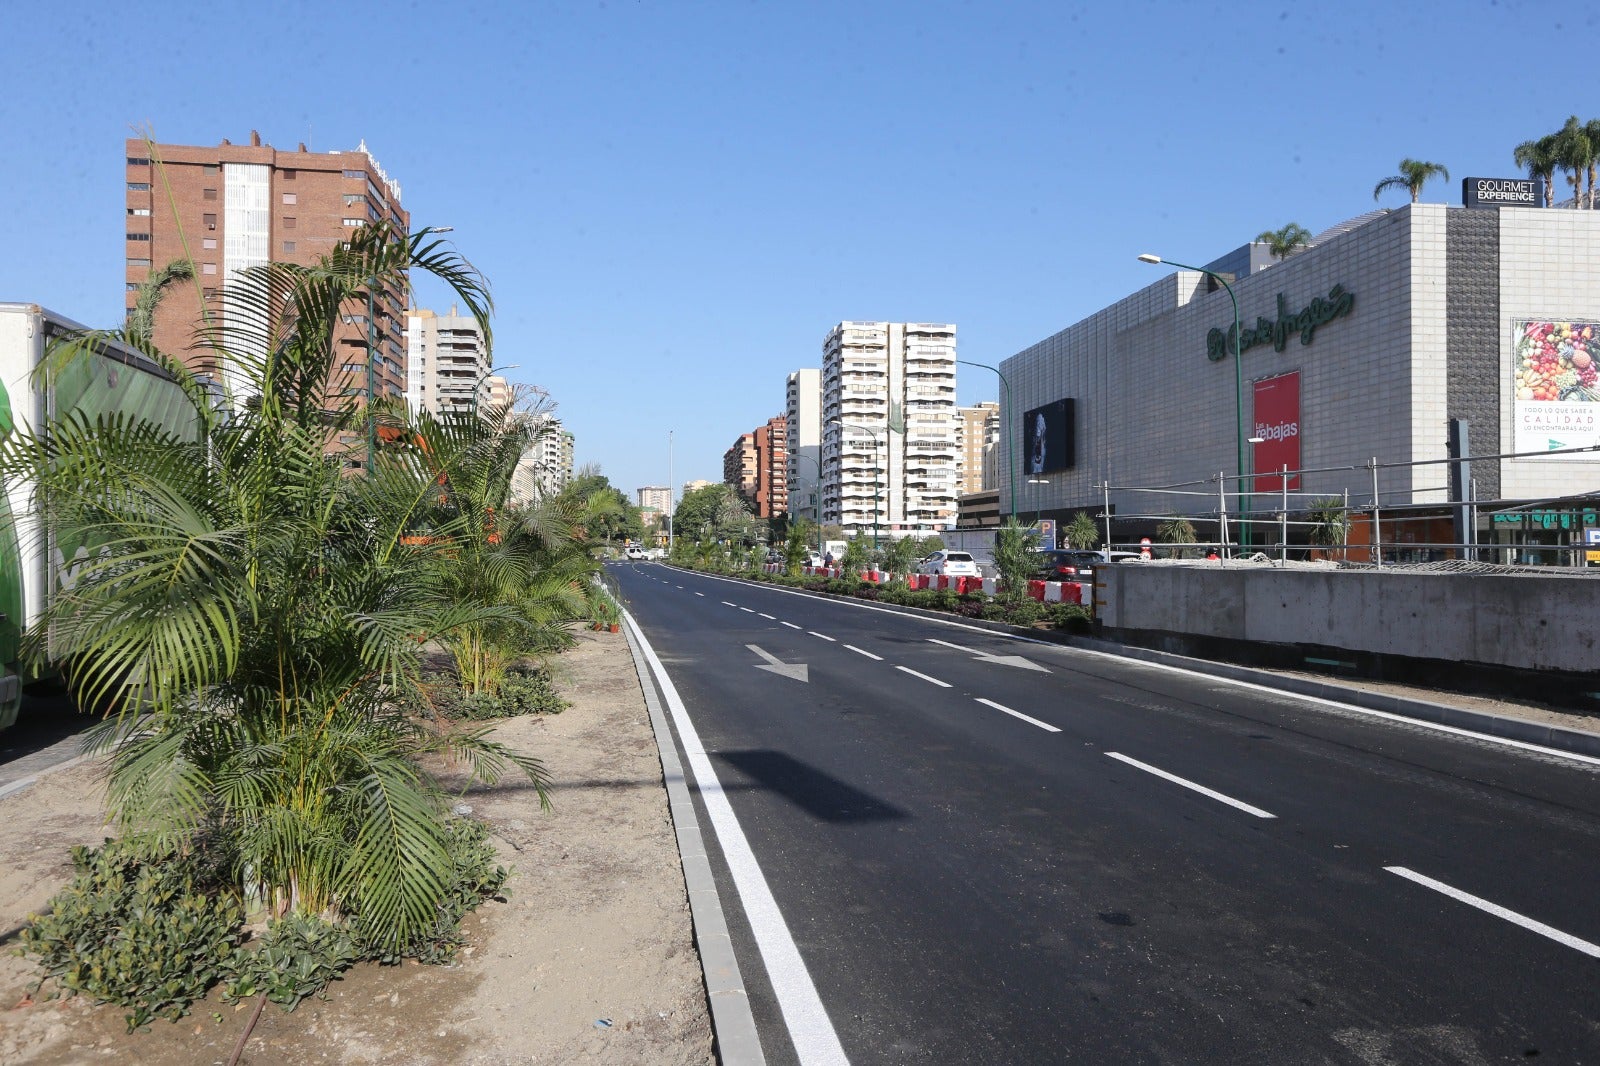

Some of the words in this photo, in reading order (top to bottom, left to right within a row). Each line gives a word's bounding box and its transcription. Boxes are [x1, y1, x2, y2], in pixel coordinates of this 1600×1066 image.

[1477, 180, 1535, 193] GOURMET
[1477, 191, 1535, 202] EXPERIENCE
[1524, 415, 1594, 424] CALIDAD
[1256, 421, 1298, 442] rebajas
[1041, 522, 1051, 534] P
